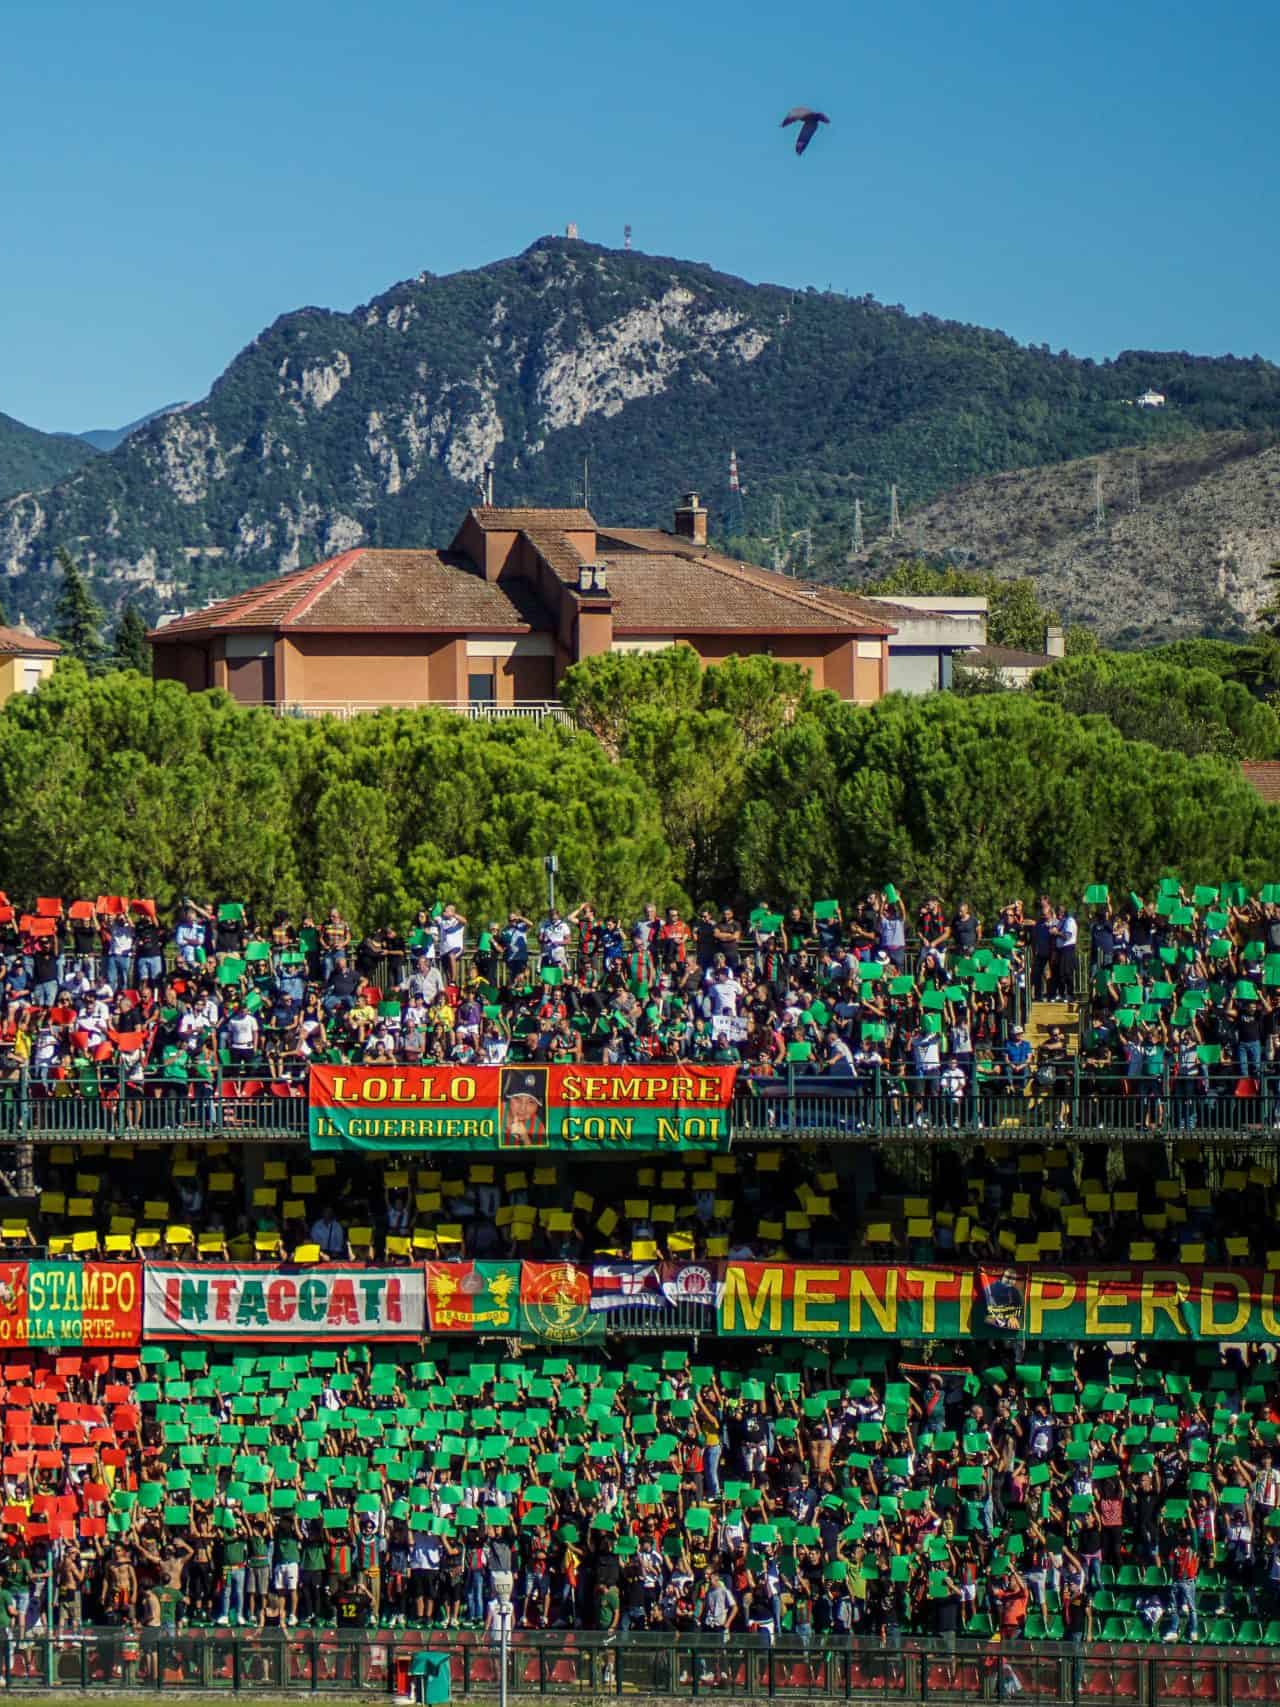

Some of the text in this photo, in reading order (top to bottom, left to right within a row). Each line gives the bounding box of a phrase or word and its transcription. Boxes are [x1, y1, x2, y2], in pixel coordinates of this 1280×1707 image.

[332, 1077, 476, 1102] LOLLO
[561, 1075, 721, 1102] SEMPRE
[317, 1118, 494, 1138] IL GUERRIERO
[561, 1117, 721, 1142] CON NOI
[28, 1271, 136, 1313] STAMPO
[164, 1277, 403, 1327] INTACCATI
[722, 1266, 974, 1334] MENTI
[15, 1318, 56, 1340] ALLA
[60, 1318, 133, 1340] MORTE...
[341, 1603, 357, 1617] 12
